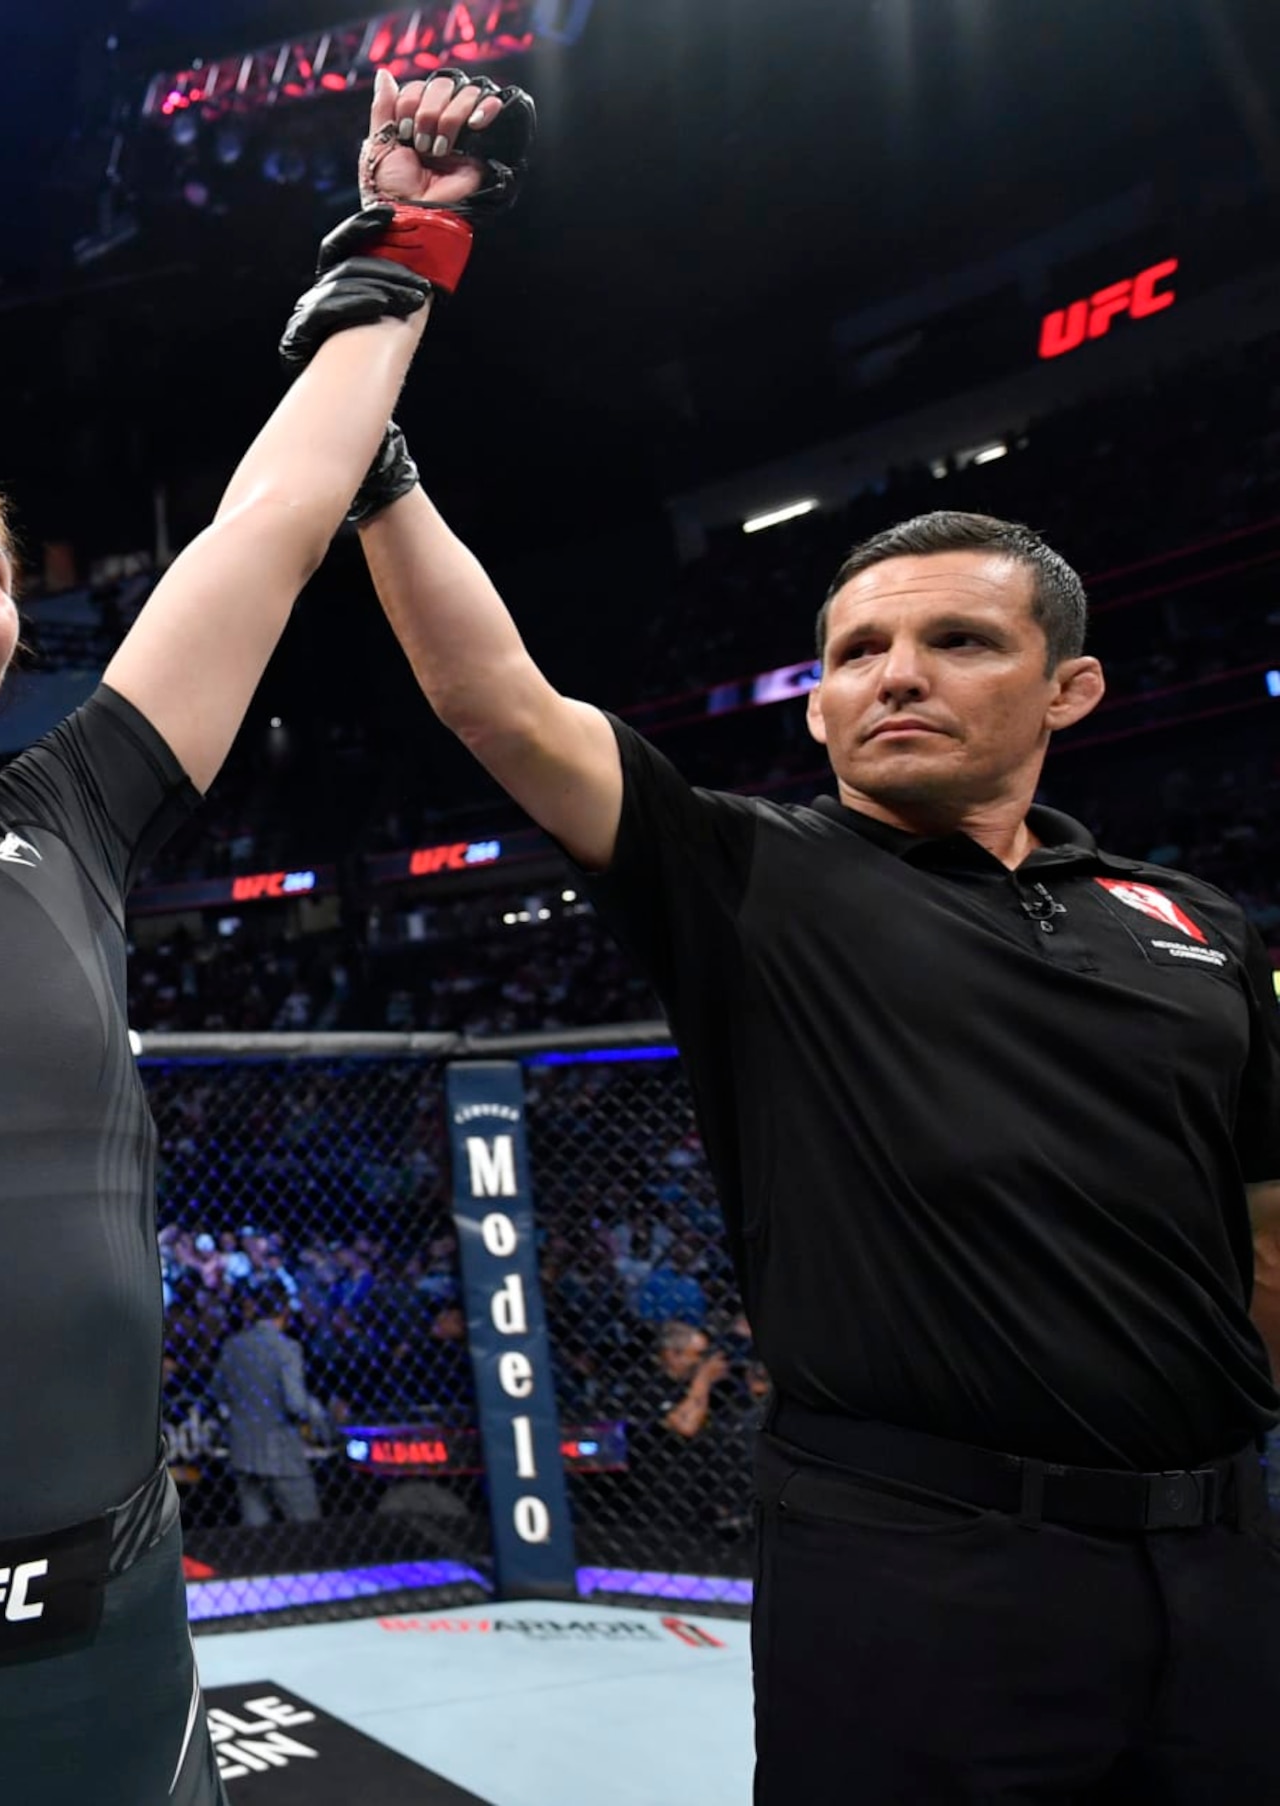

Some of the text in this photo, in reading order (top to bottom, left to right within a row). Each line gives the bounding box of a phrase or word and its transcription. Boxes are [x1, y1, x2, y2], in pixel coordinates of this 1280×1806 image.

[1038, 258, 1178, 360] UFC
[232, 872, 284, 900] UFC
[411, 843, 467, 875] UFC
[467, 1134, 550, 1542] Modelo
